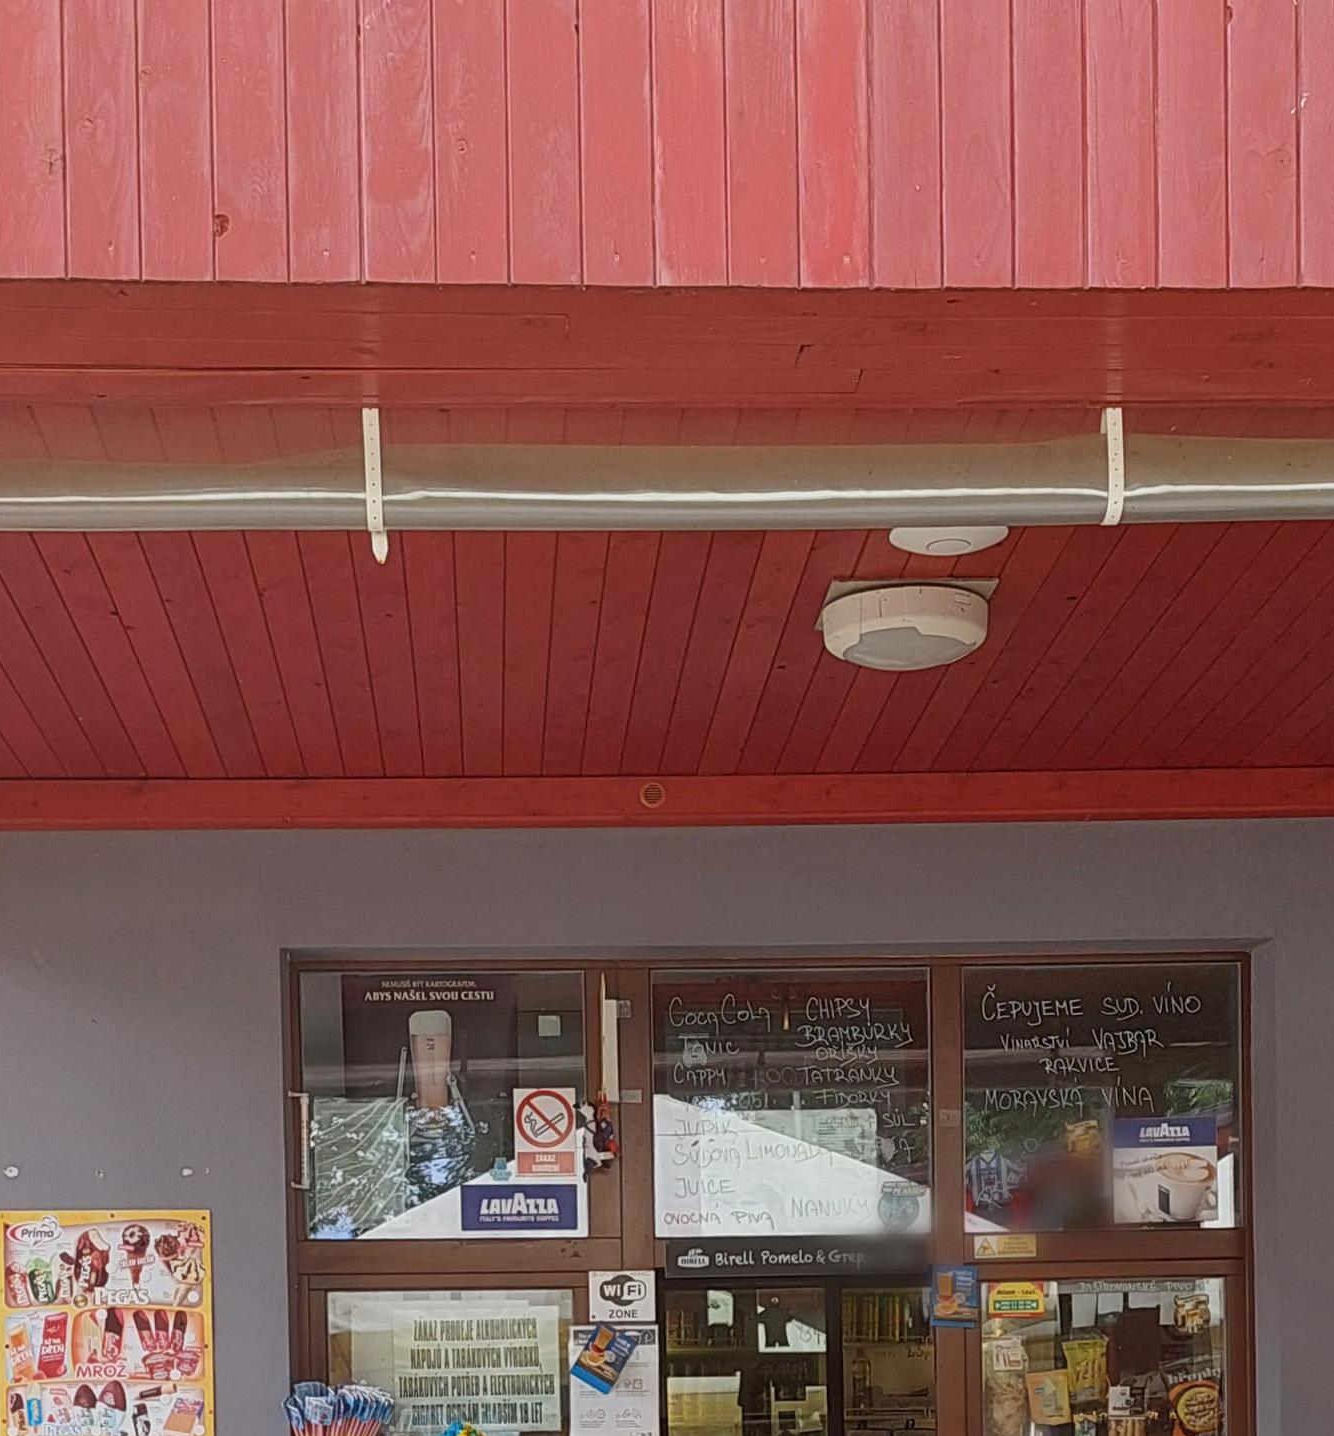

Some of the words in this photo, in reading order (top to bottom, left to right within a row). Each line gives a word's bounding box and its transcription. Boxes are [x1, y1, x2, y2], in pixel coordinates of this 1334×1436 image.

[1139, 1122, 1191, 1139] LAVAZZA
[674, 1178, 736, 1198] JUICE
[479, 1193, 560, 1215] LAVAZZA
[20, 1226, 55, 1240] Prima
[715, 1252, 755, 1267] Birell
[760, 1250, 814, 1266] Pomelo
[608, 1308, 639, 1319] ZONE
